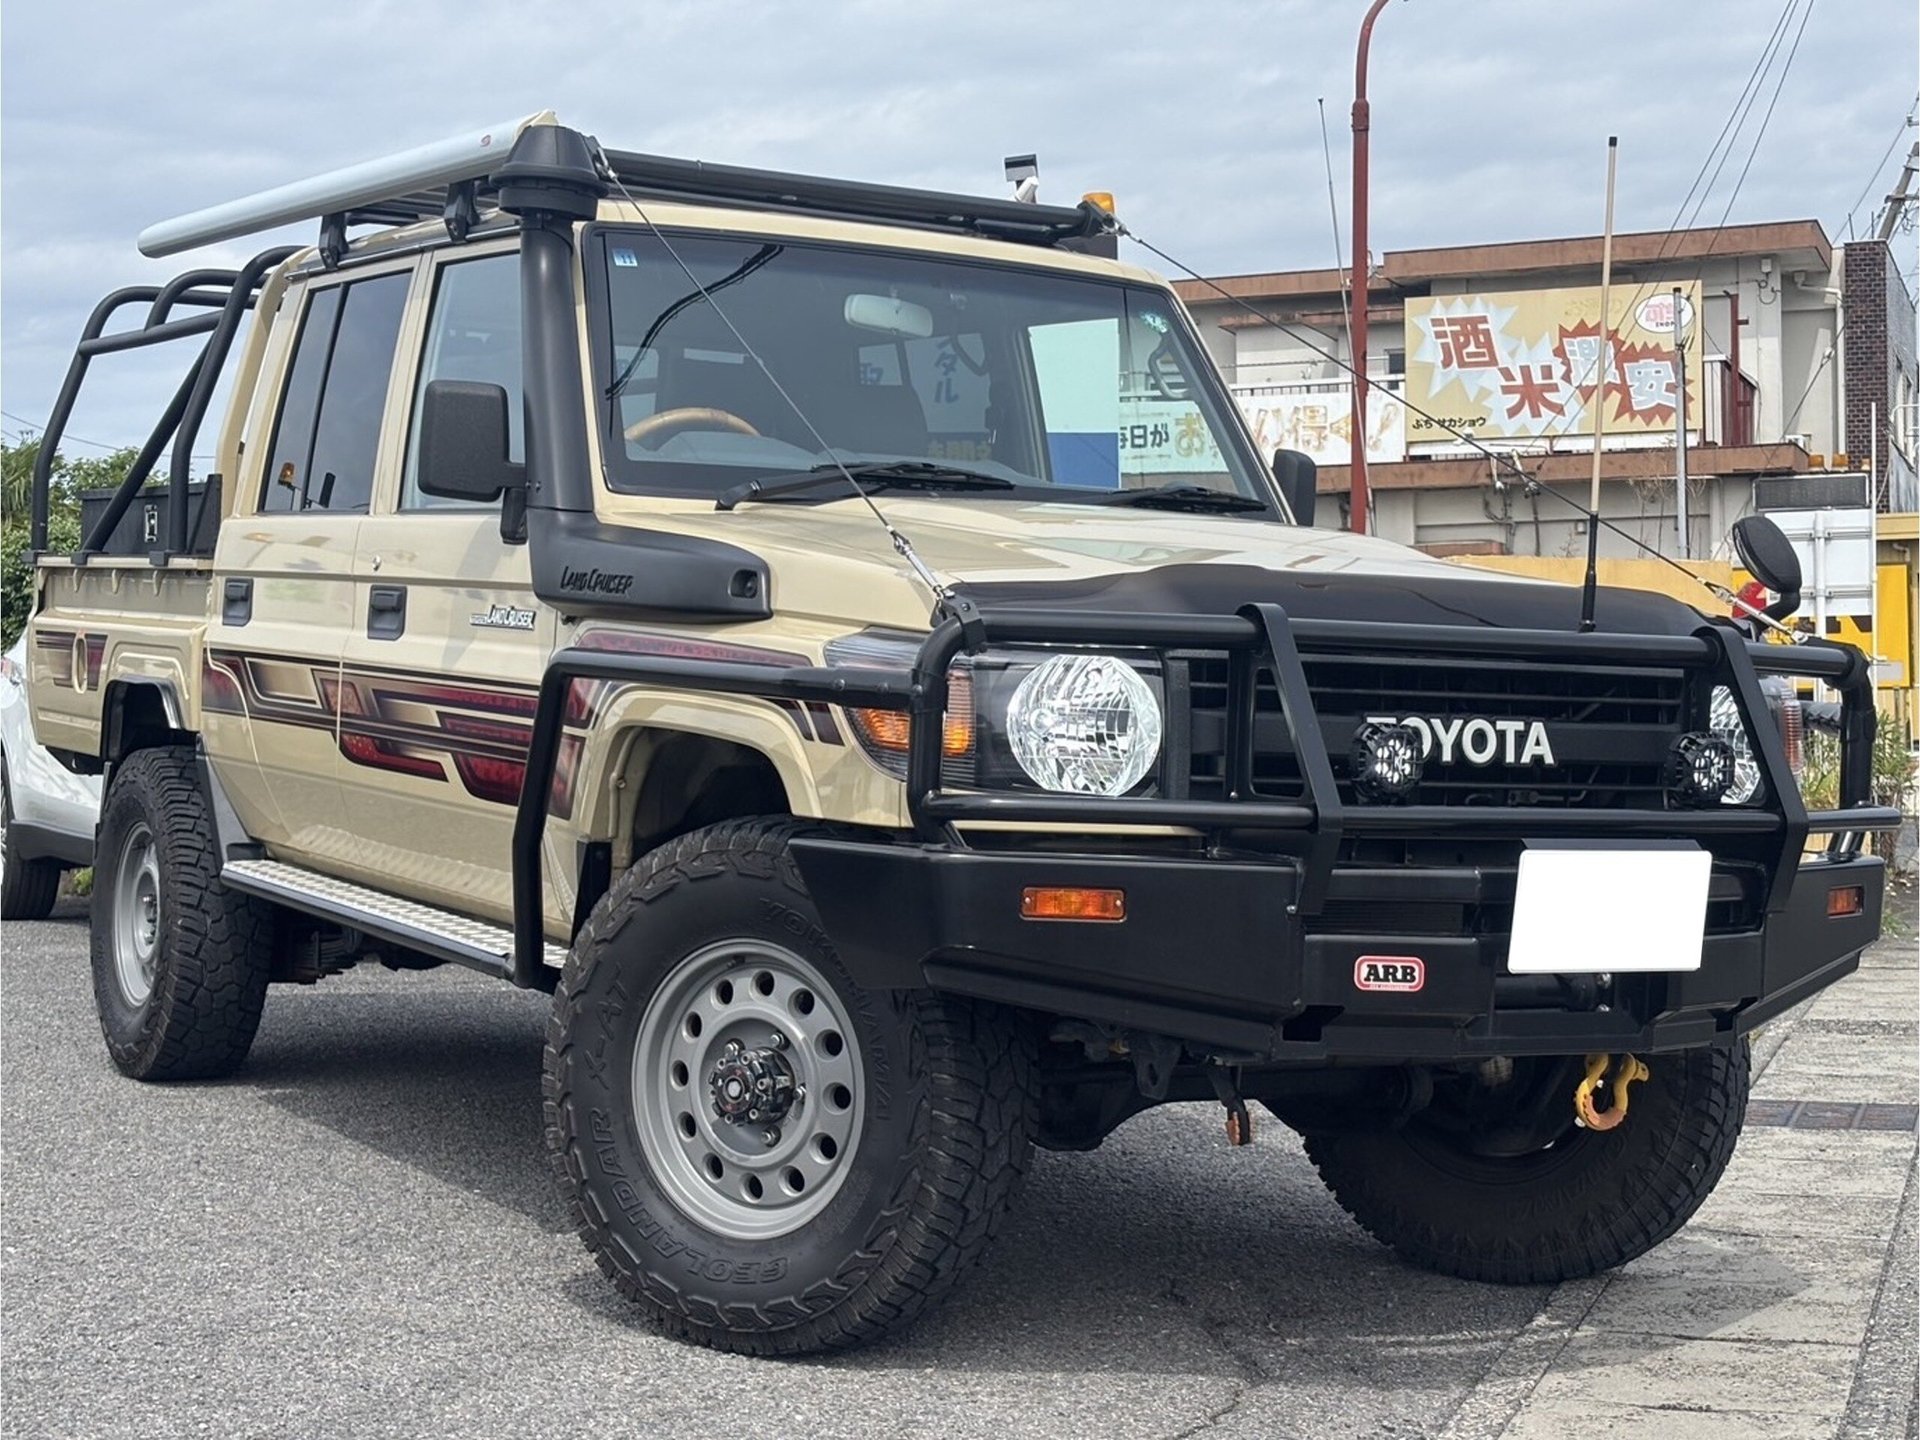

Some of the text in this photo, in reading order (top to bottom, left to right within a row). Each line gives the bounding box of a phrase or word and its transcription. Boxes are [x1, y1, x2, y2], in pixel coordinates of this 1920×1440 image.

[1430, 315, 1498, 369] 酒
[1501, 364, 1567, 419] 米
[1363, 964, 1417, 983] ARB
[592, 1106, 788, 1286] GEOLANDAR
